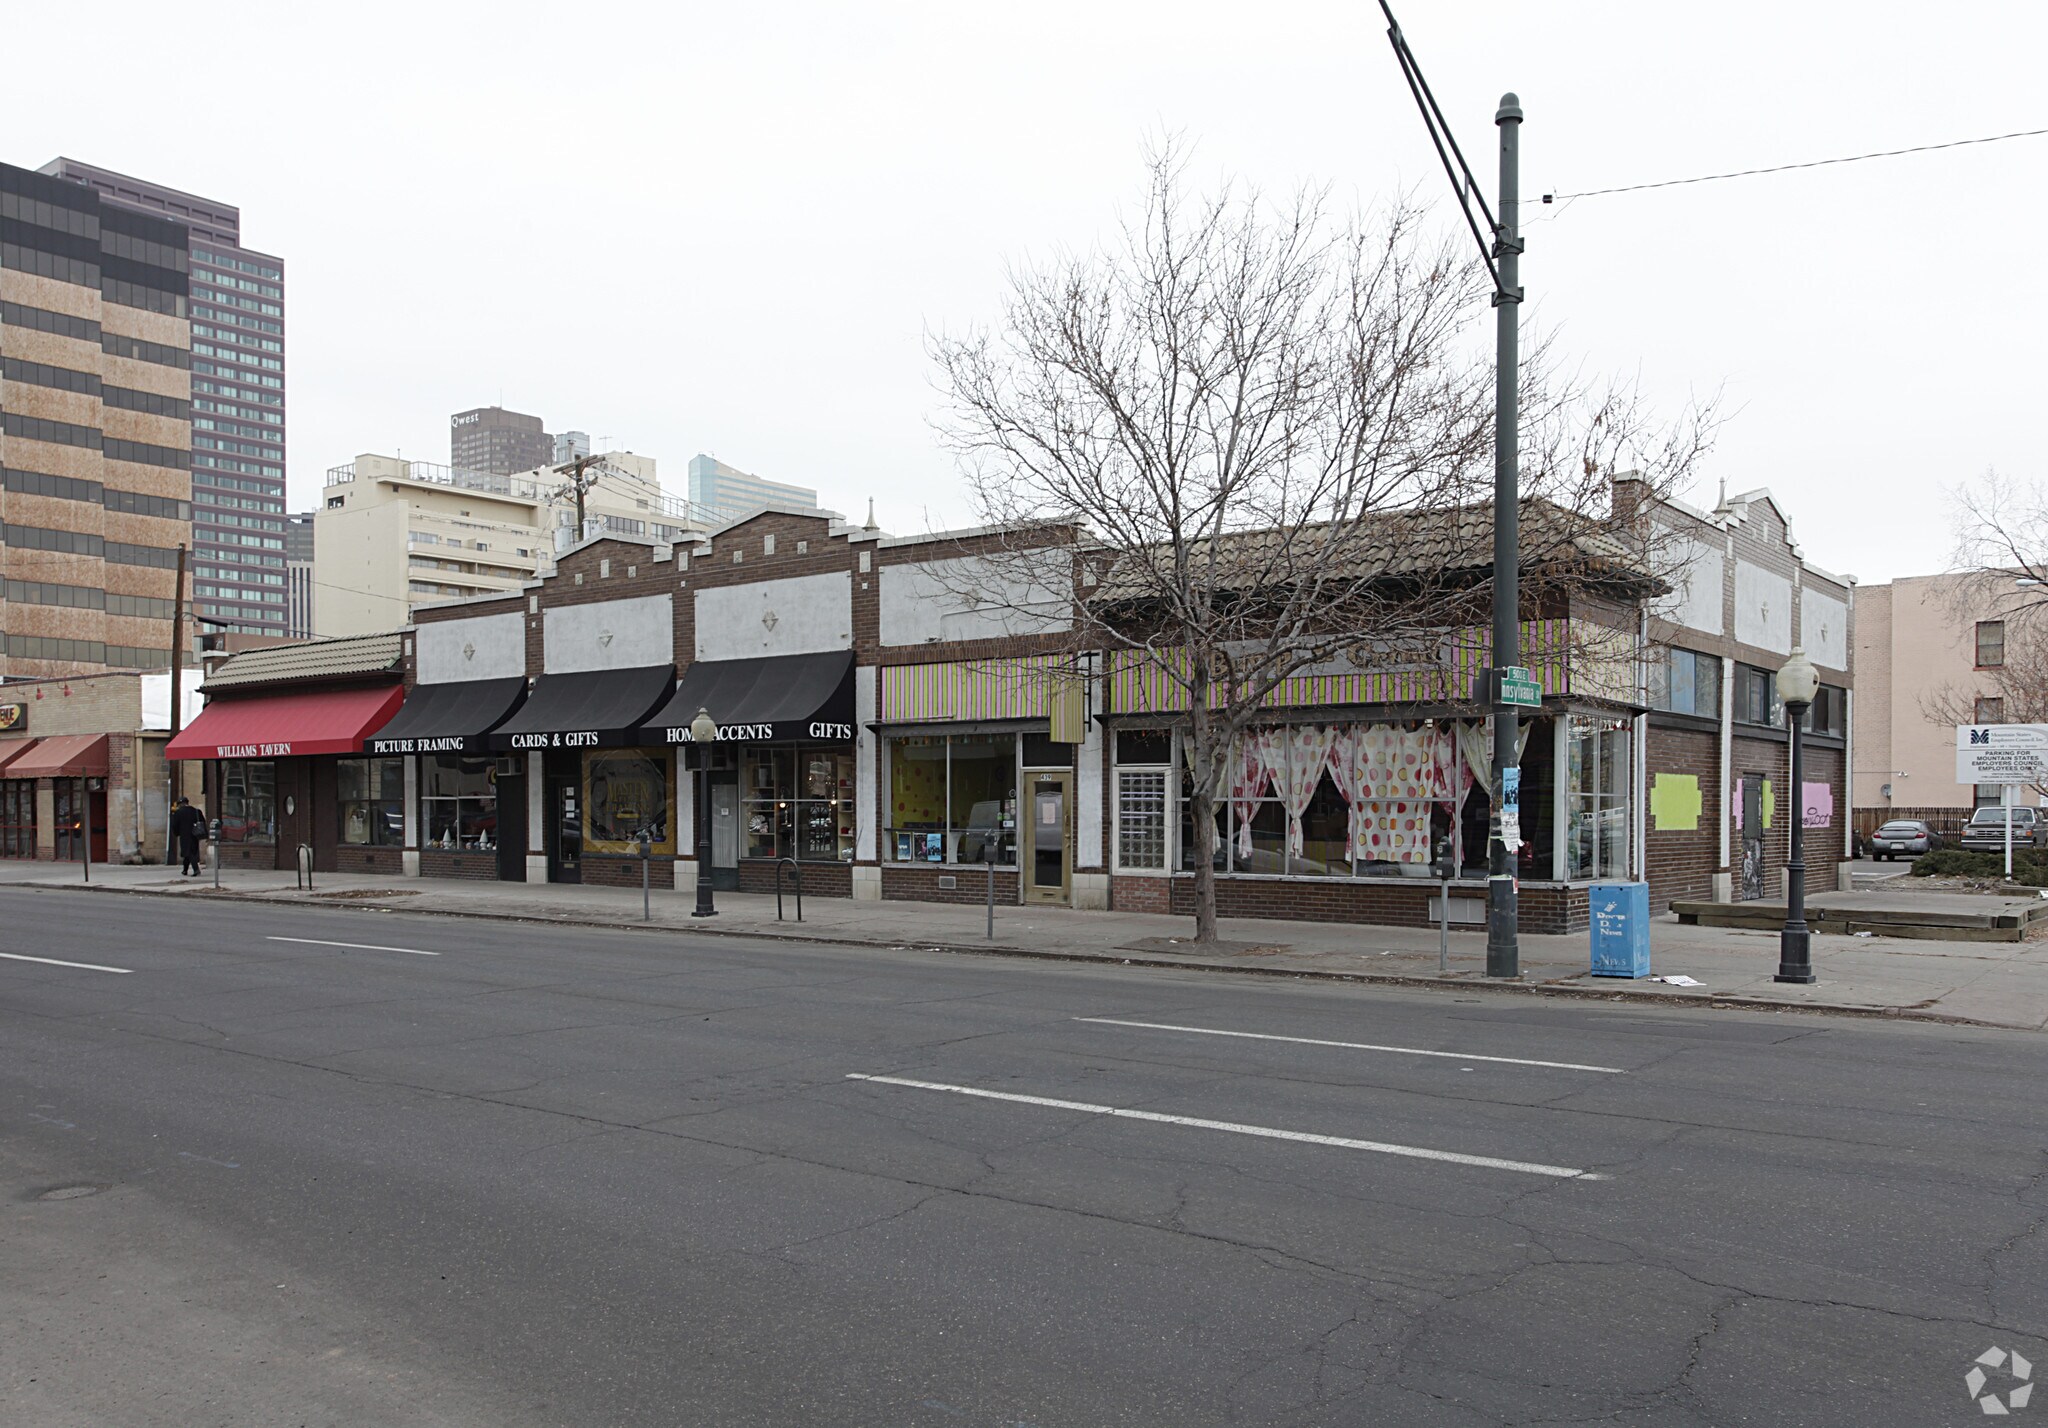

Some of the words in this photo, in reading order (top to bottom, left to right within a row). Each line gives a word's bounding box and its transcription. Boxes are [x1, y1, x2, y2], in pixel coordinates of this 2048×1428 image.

[451, 413, 479, 428] Qwest
[1513, 669, 1522, 679] 500
[1502, 683, 1534, 703] nnsylvania
[666, 727, 696, 743] HOM
[712, 724, 773, 741] ACCENTS
[809, 722, 851, 739] GIFTS
[374, 740, 414, 753] PICTURE
[418, 737, 464, 751] FRAMING
[511, 734, 548, 748] CARDS
[552, 734, 561, 747] &
[565, 731, 599, 747] GIFTS
[217, 745, 257, 758] WILLIAMS
[260, 742, 291, 756] TAVERN
